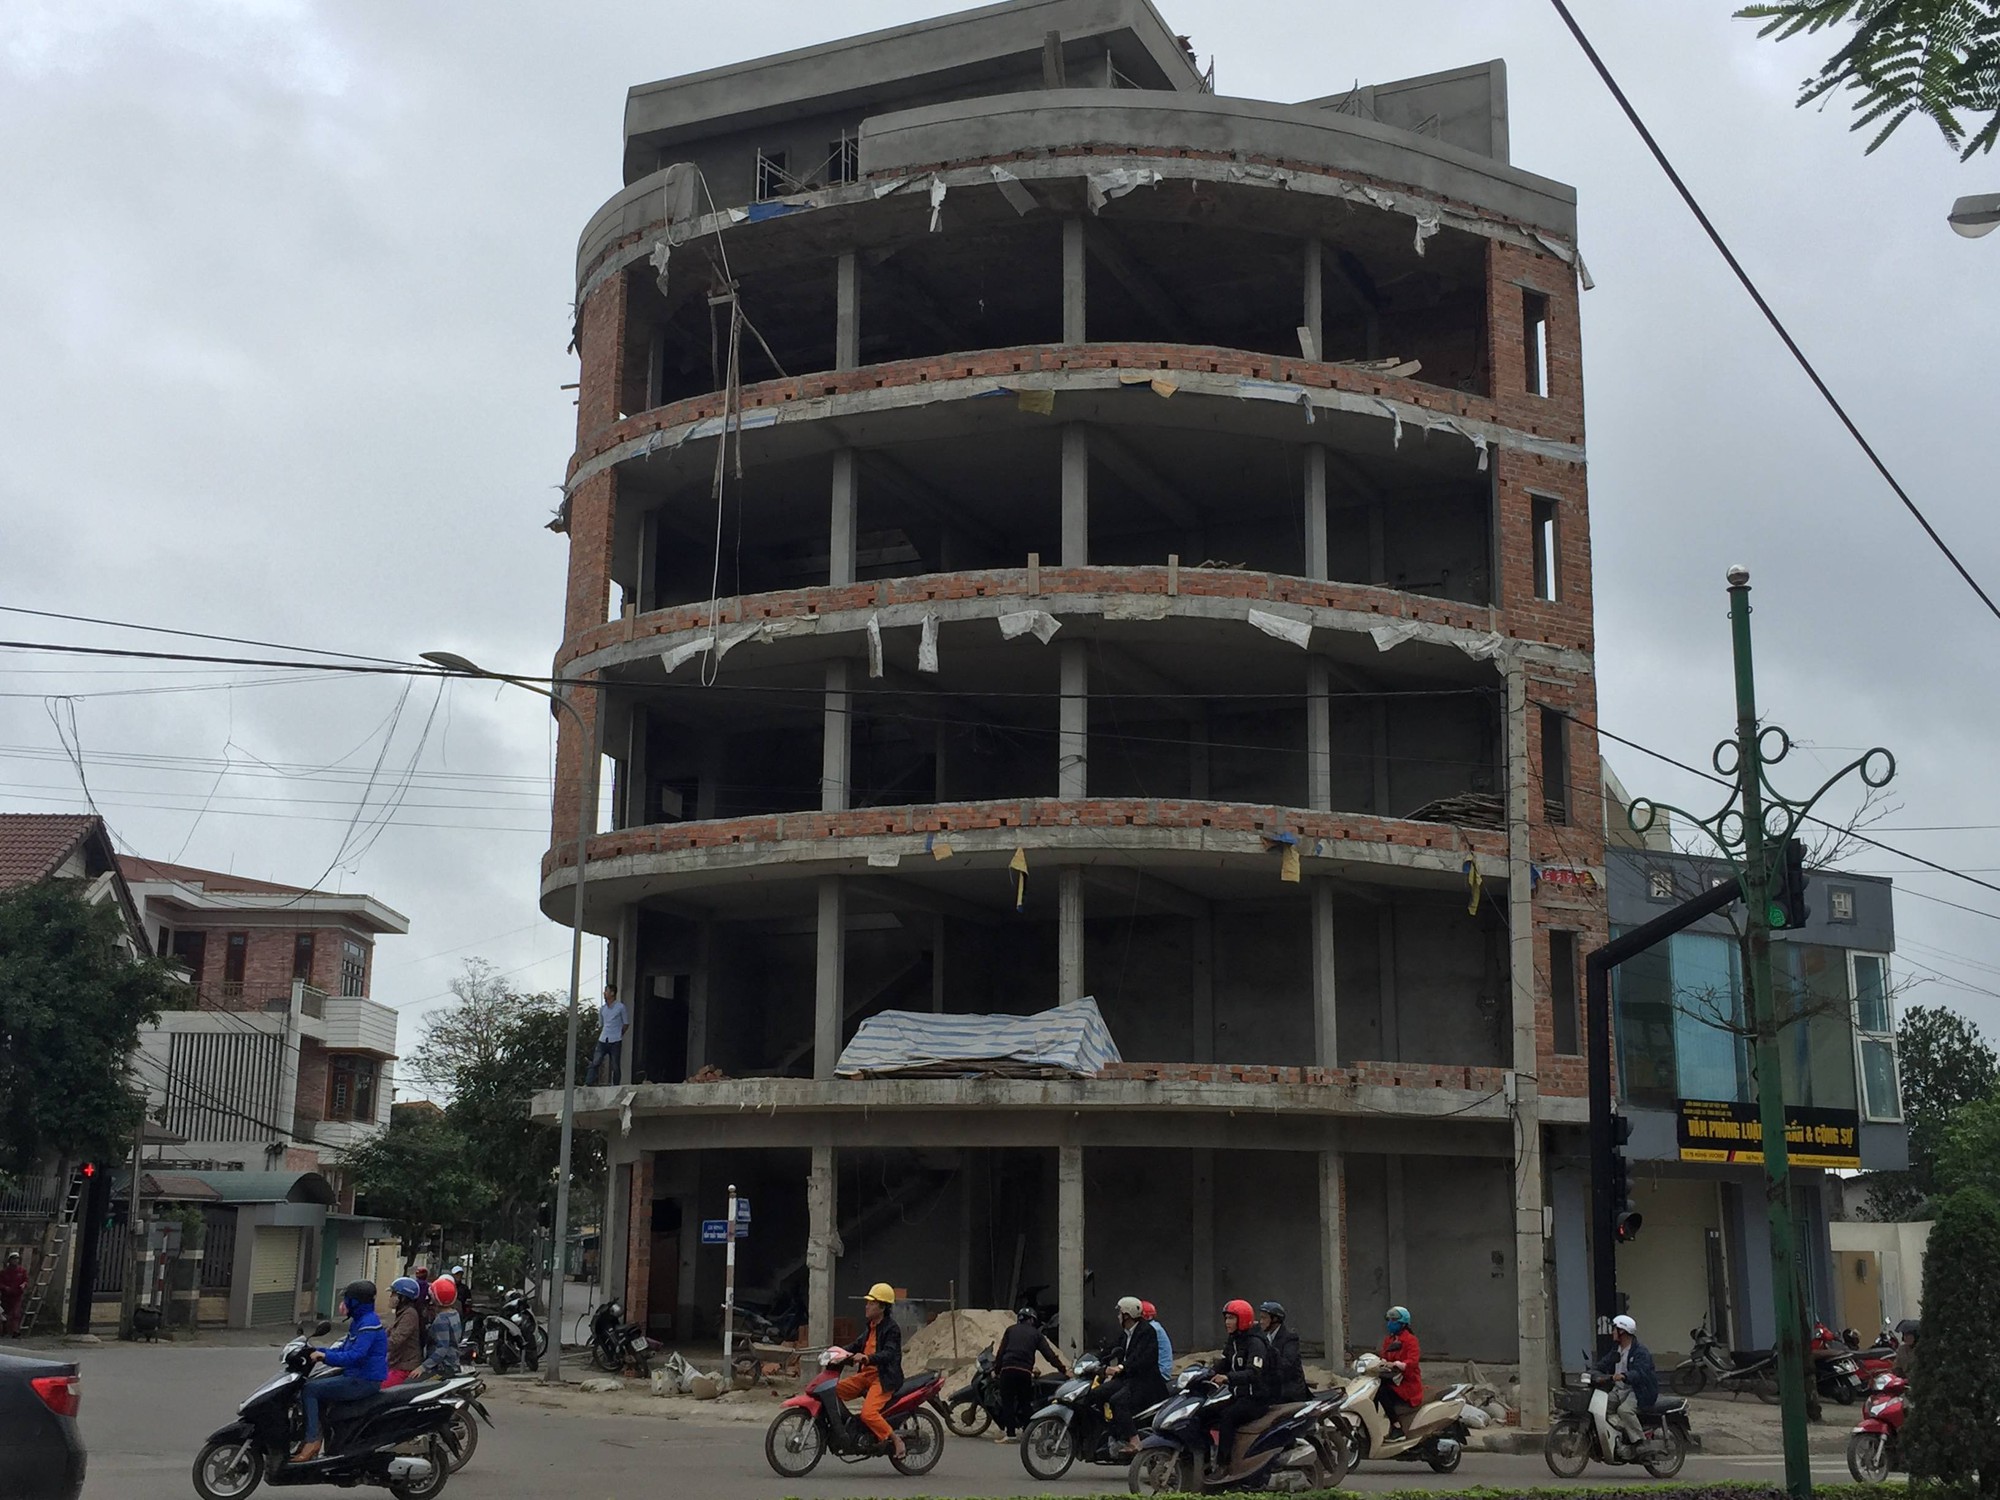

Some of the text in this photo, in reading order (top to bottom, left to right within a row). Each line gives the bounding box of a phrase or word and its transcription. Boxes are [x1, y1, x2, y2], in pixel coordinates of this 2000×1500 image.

[1688, 1116, 1707, 1137] VĂN
[1708, 1117, 1740, 1139] PHÒNG
[1784, 1119, 1804, 1143] RẦN
[1805, 1125, 1813, 1143] &
[1814, 1123, 1839, 1147] CỘNG
[1840, 1127, 1854, 1148] SỰ
